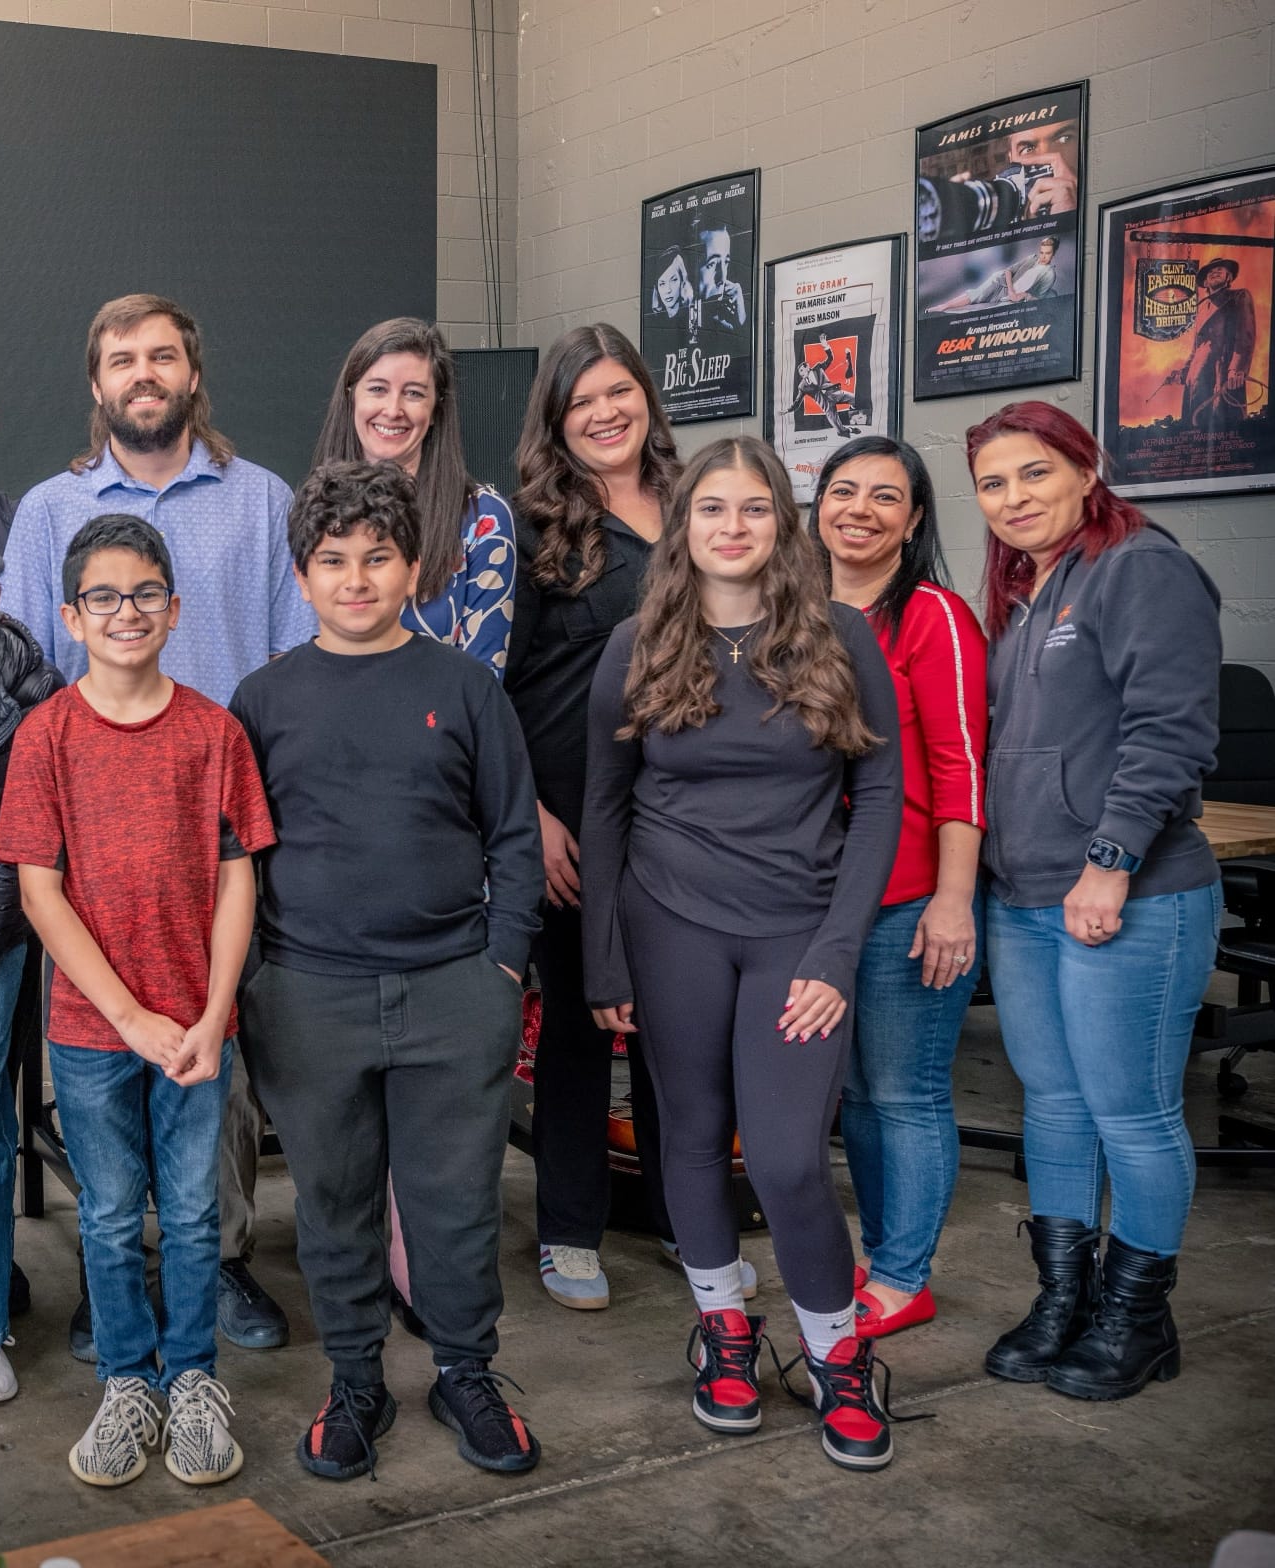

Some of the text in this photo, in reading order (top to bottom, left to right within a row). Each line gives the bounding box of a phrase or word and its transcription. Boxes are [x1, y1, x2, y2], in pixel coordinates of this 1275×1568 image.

[938, 105, 1058, 147] JAMES STEWART
[701, 193, 722, 205] CHANDLER
[724, 186, 745, 199] FAULKNER
[1161, 264, 1185, 274] CLINT
[796, 277, 848, 295] CARY GRANT
[1147, 274, 1196, 293] EASTWOOD
[796, 293, 846, 311] EVA MARIE SAINT
[1145, 294, 1197, 316] HIGH PLAINS
[796, 310, 840, 326] JAMES MASON
[1155, 315, 1186, 328] DRIFTER
[965, 319, 1020, 336] ALFRED HITCHCOCK'S
[936, 324, 1051, 355] REAR WINDOW
[678, 347, 687, 359] THE
[662, 348, 731, 391] BIG SLEEP
